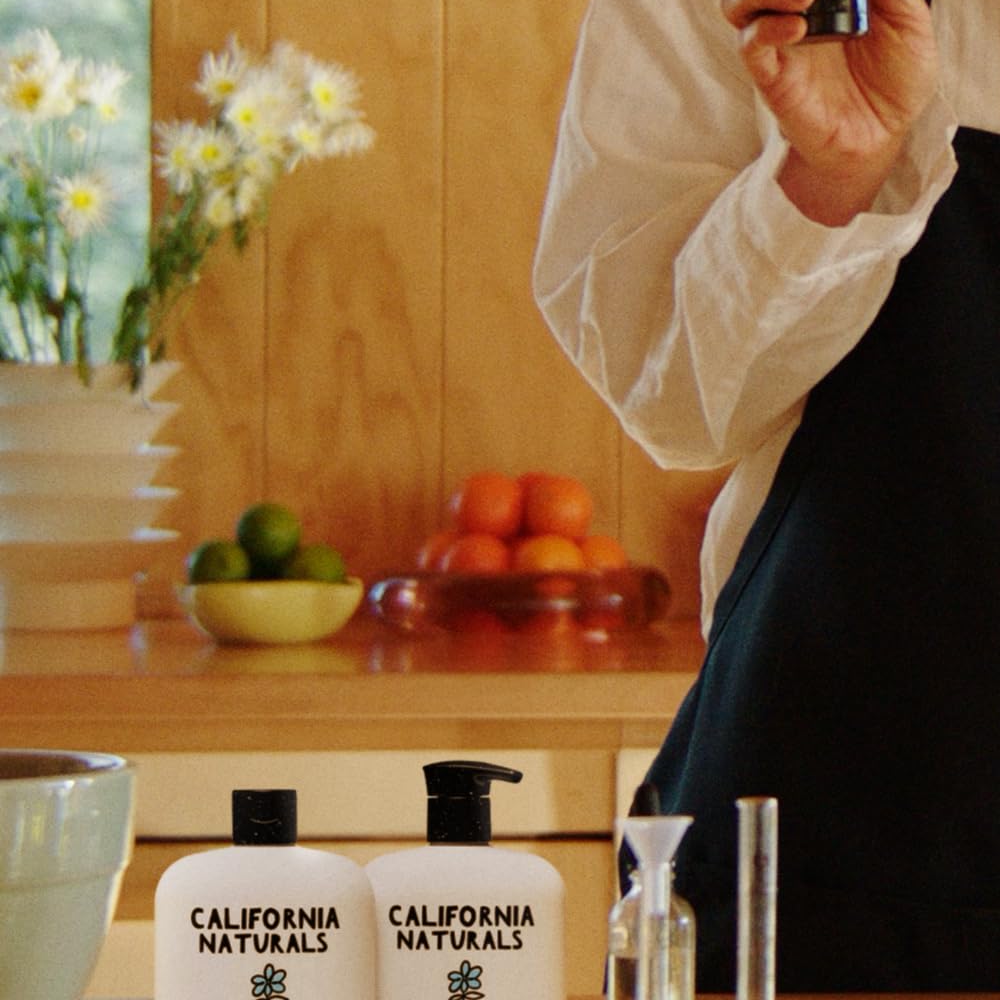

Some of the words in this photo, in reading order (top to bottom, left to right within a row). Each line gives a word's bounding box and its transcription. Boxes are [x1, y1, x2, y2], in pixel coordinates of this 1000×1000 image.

[191, 907, 340, 931] CALIFORNIA
[389, 904, 535, 928] CALIFORNIA
[199, 931, 329, 954] NATURALS
[396, 929, 523, 951] NATURALS
